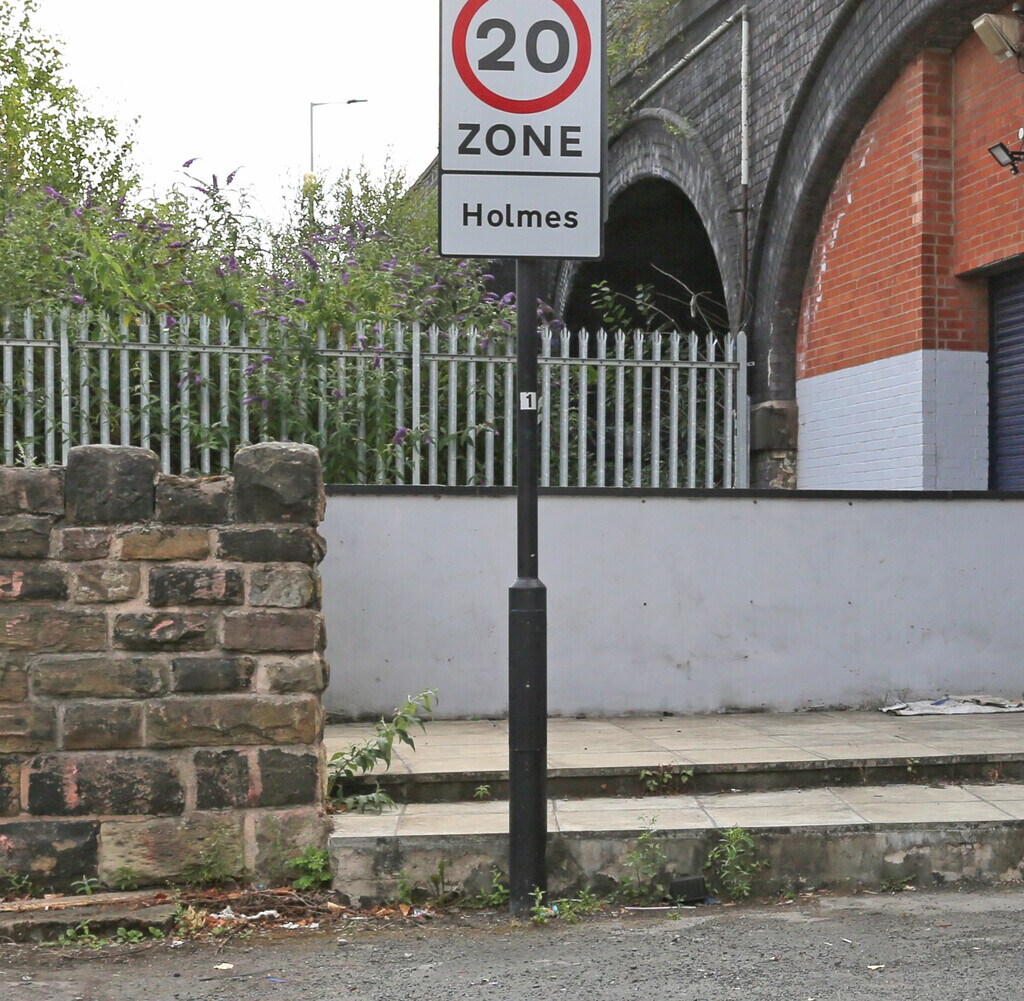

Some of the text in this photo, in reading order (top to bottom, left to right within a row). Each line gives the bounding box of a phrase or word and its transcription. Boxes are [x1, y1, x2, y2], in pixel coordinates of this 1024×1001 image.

[476, 18, 570, 74] 20
[458, 123, 582, 157] ZONE
[463, 203, 578, 228] Holmes
[526, 394, 532, 407] 1
